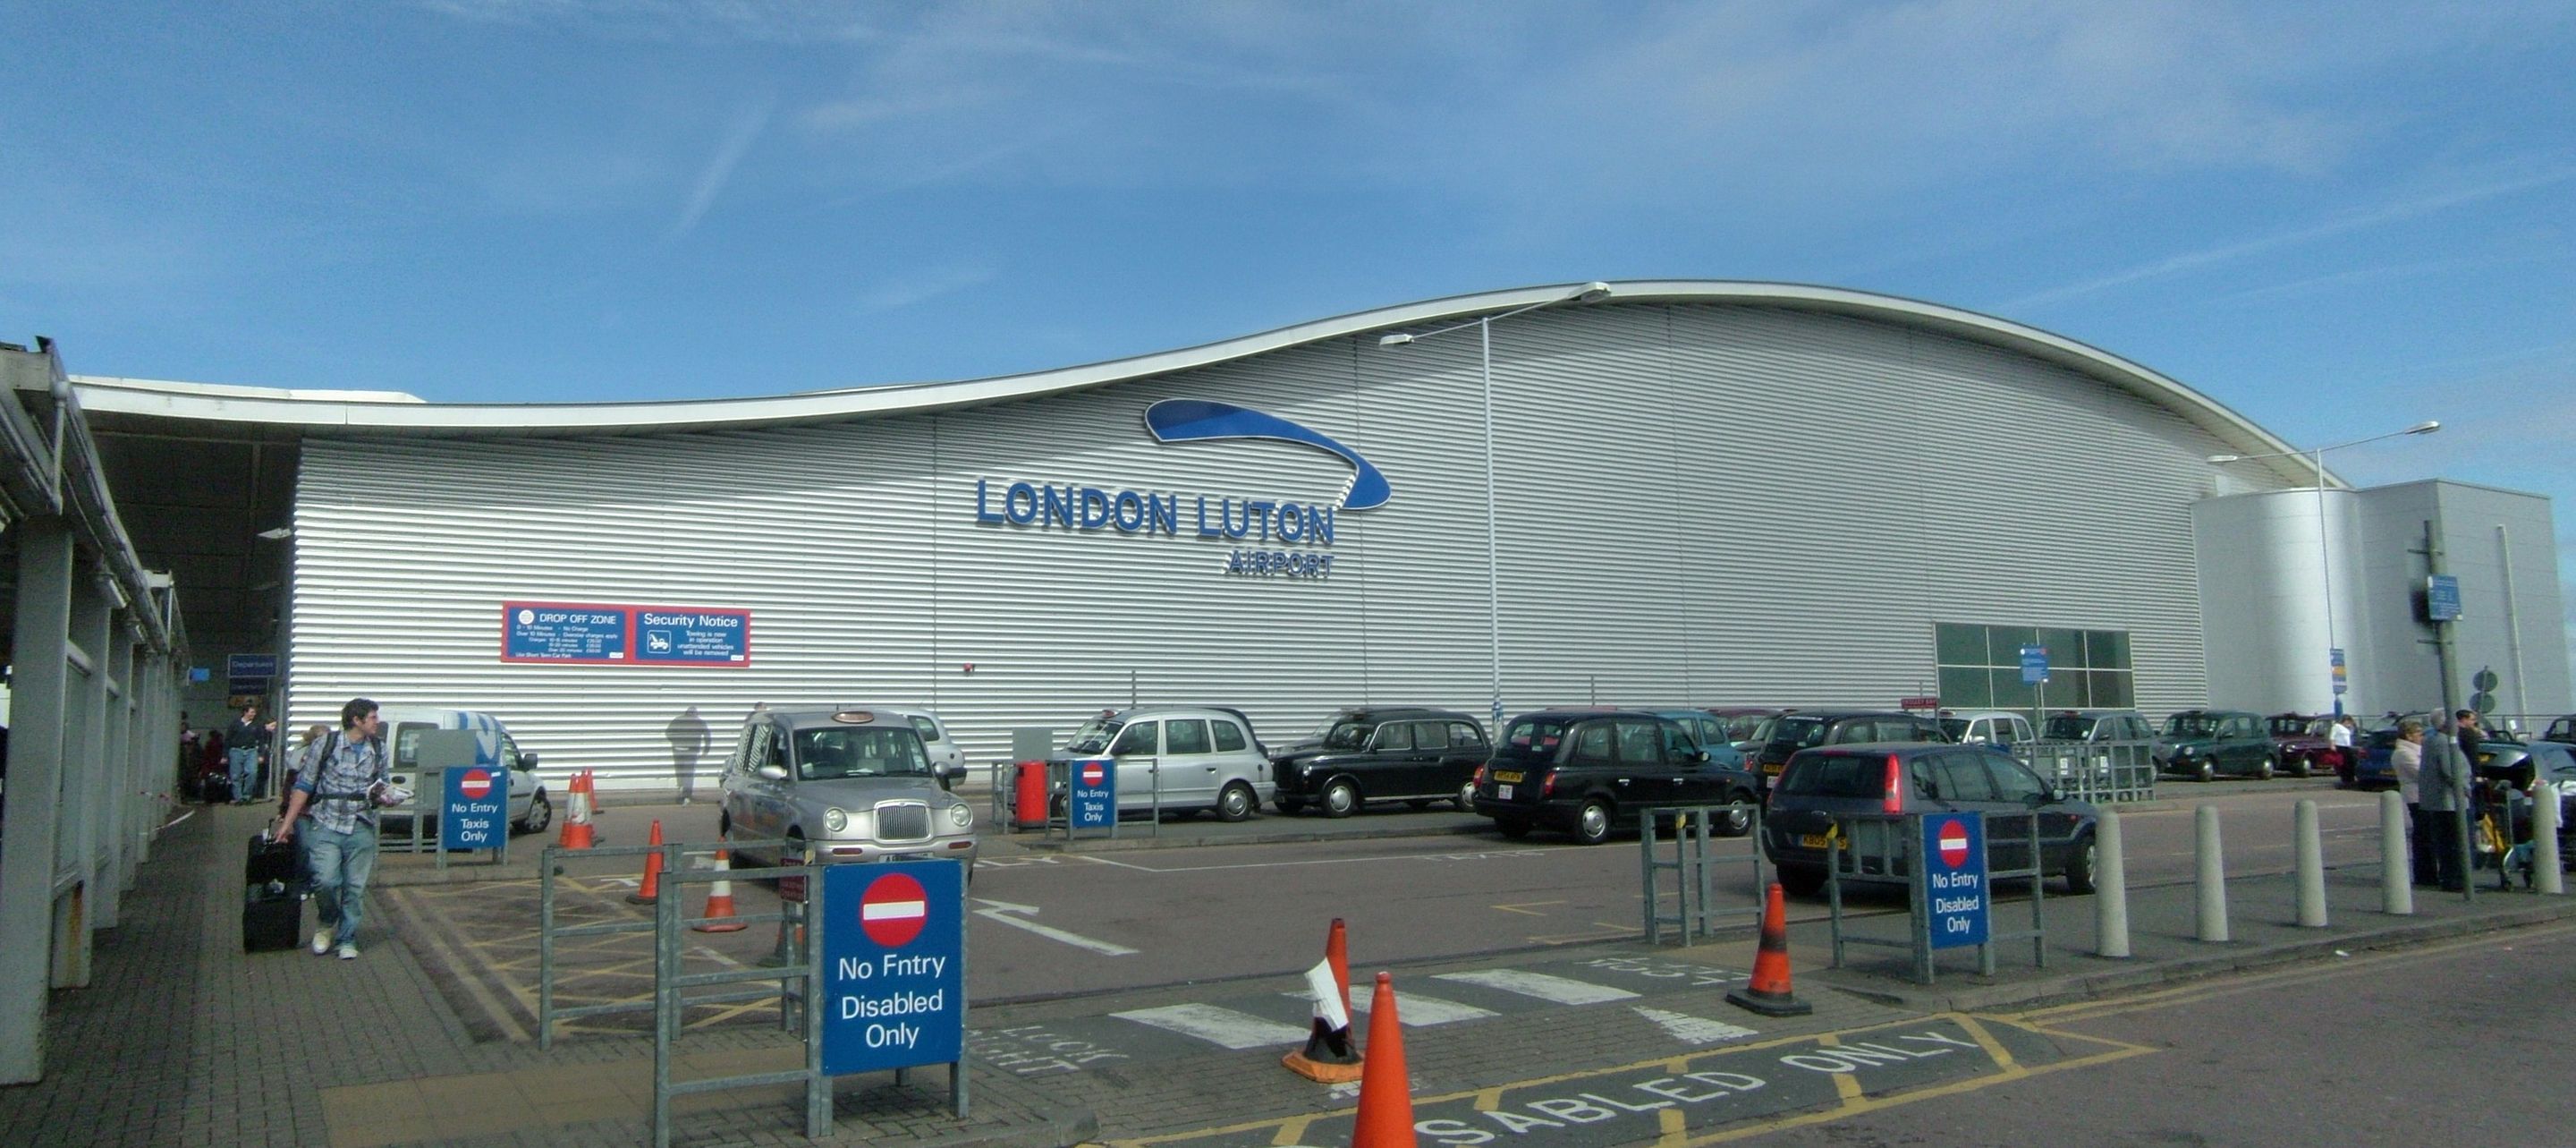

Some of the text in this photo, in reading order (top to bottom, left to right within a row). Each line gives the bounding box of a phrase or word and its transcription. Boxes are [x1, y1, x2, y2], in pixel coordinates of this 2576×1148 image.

[977, 479, 1335, 545] LONDON LUTON
[1229, 549, 1335, 577] AIRPORT
[539, 613, 567, 623] DROP
[570, 614, 588, 624] OFF
[590, 615, 616, 625] ZONE
[644, 613, 738, 628] Security Notice
[1077, 789, 1109, 799] No Entry
[452, 803, 498, 814] No Entry
[1084, 802, 1104, 812] Taxis
[460, 818, 490, 829] Taxis
[1084, 812, 1103, 822] Only
[461, 830, 487, 844] Only
[1932, 872, 1979, 889] No Entry
[1936, 895, 1979, 914] Disabled
[1947, 916, 1970, 934] Only
[839, 957, 873, 981] No
[842, 988, 944, 1020] Disabled
[865, 1022, 920, 1050] Only
[1413, 1031, 1979, 1145] SABLED ONLY
